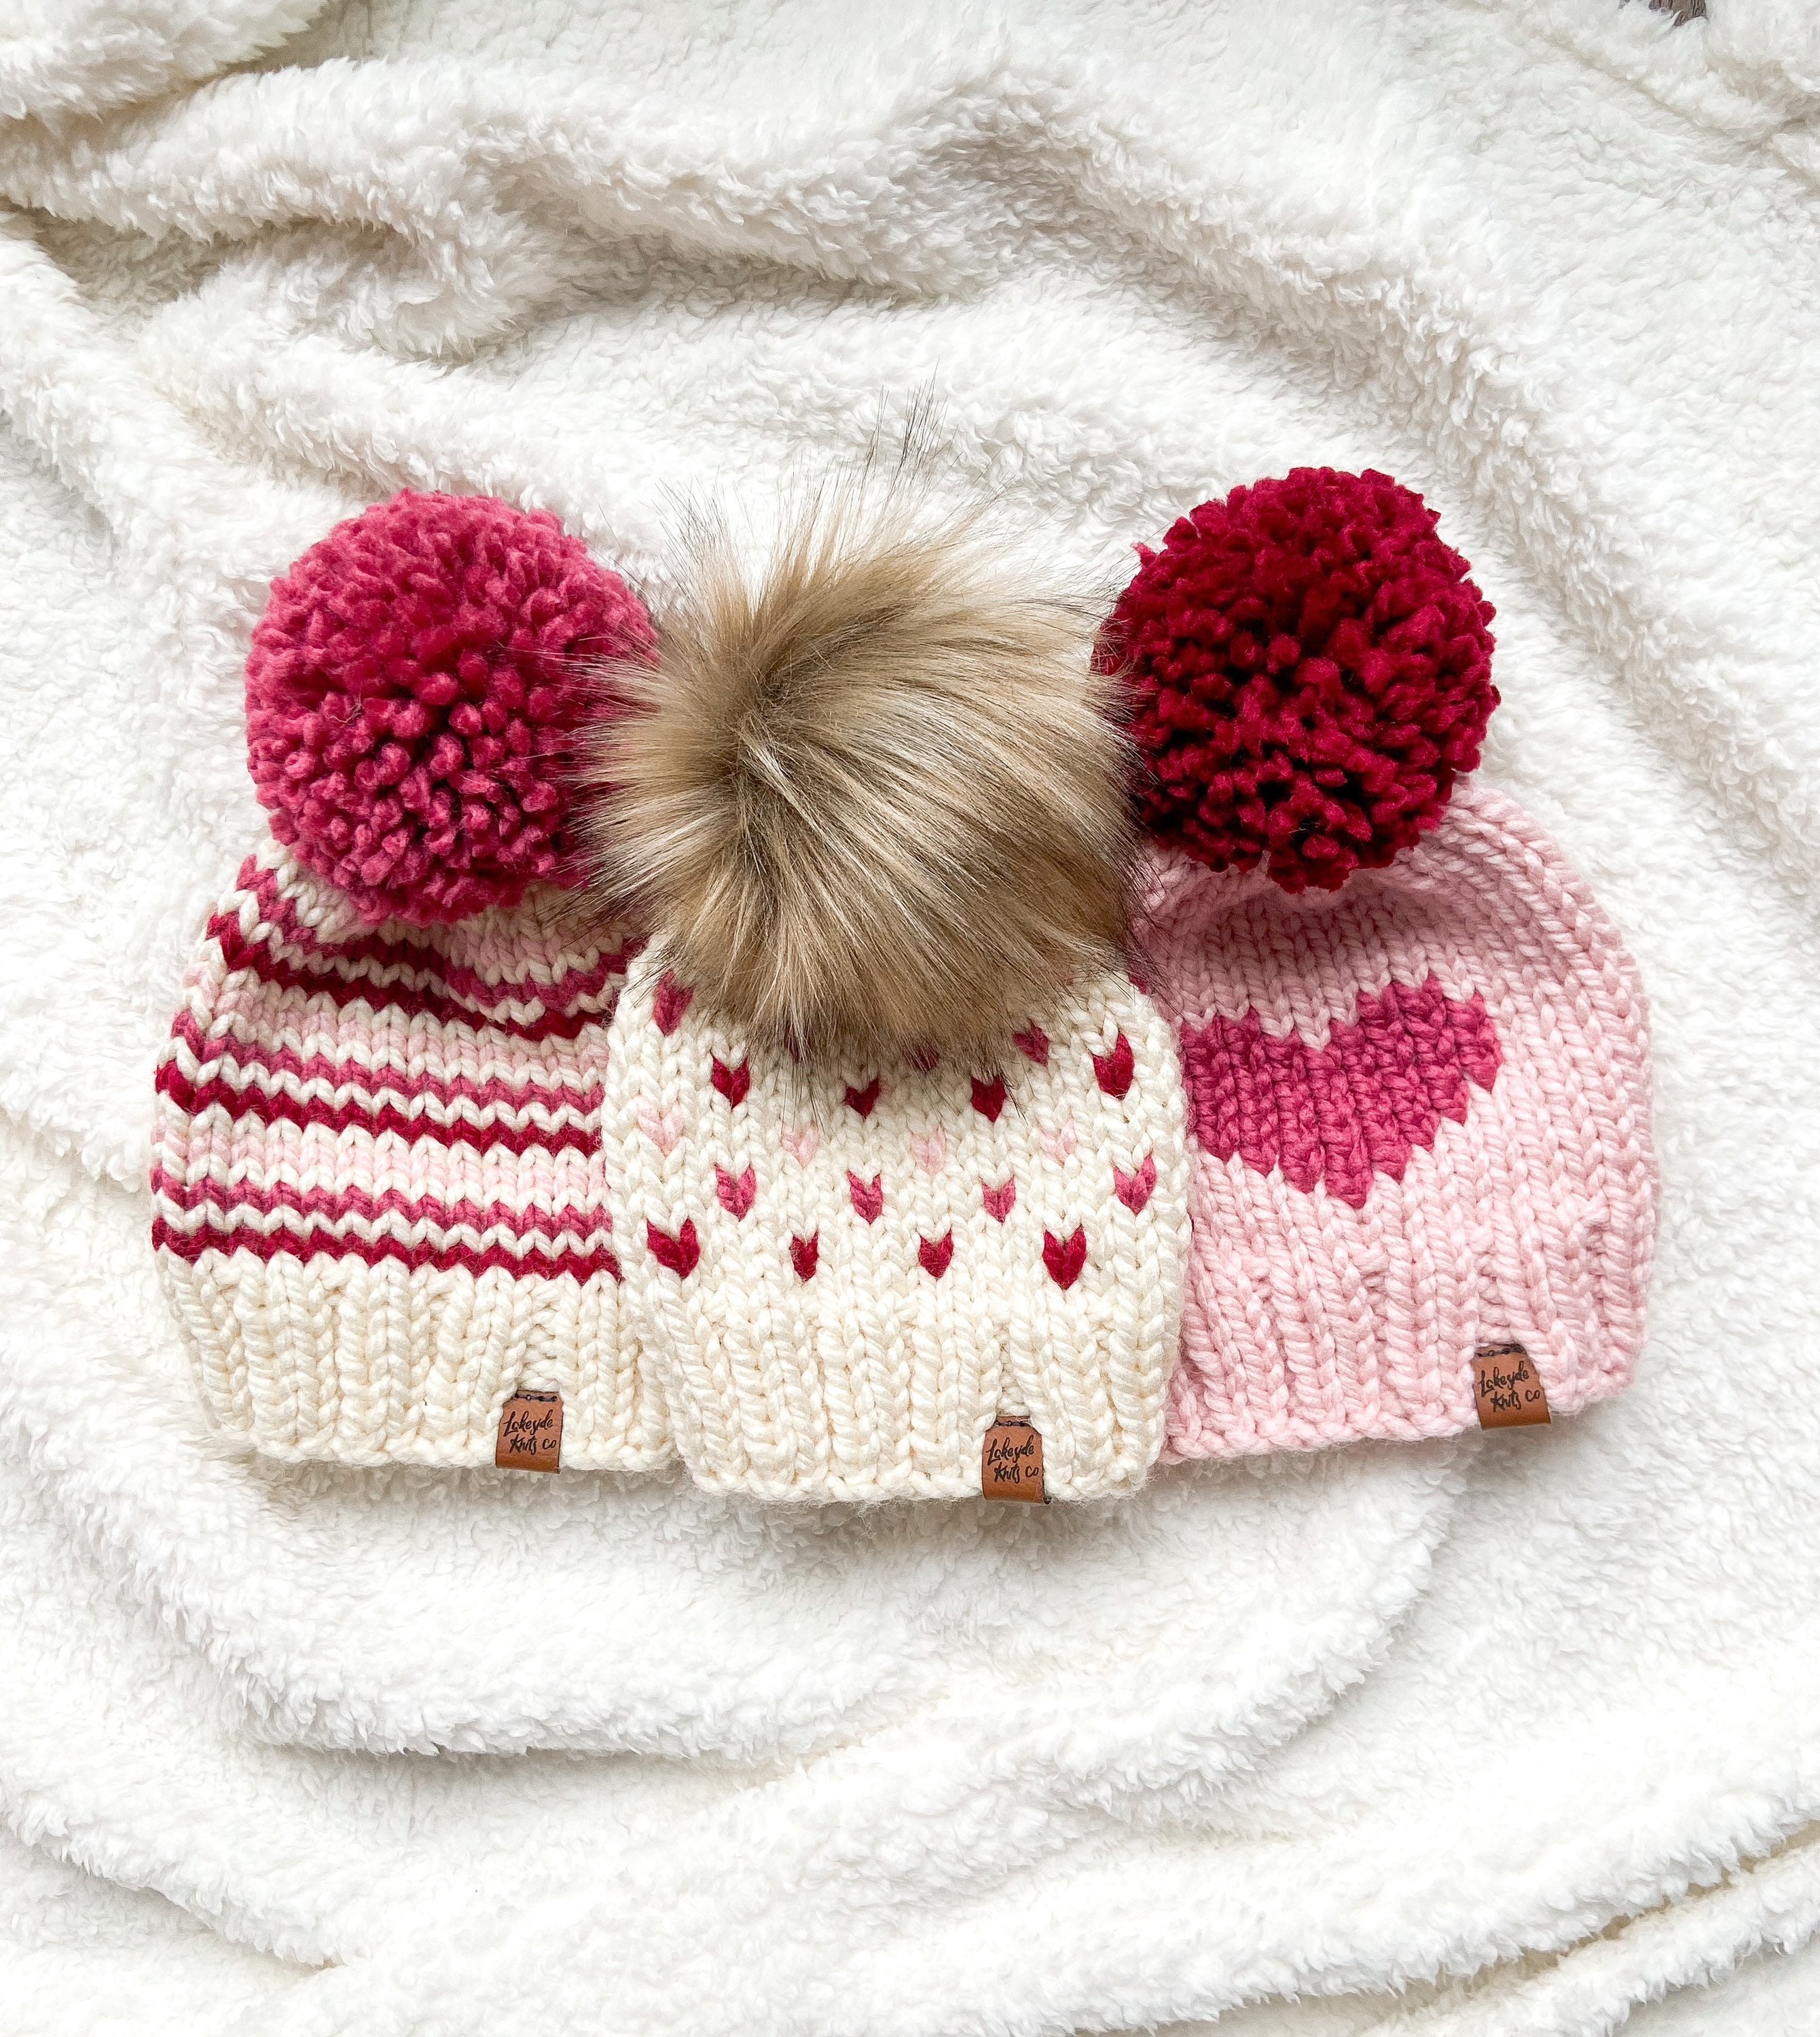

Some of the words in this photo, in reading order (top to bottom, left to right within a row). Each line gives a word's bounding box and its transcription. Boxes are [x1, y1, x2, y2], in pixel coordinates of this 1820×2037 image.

[1478, 1360, 1529, 1398] Lakeside
[1490, 1391, 1522, 1413] Knits
[1525, 1389, 1540, 1402] Co
[503, 1409, 553, 1437] Lakeside
[509, 1433, 537, 1456] Knits
[542, 1438, 557, 1450] Co
[985, 1434, 1034, 1466] Lakeside
[994, 1461, 1020, 1484] Knits
[1025, 1465, 1039, 1478] Co
